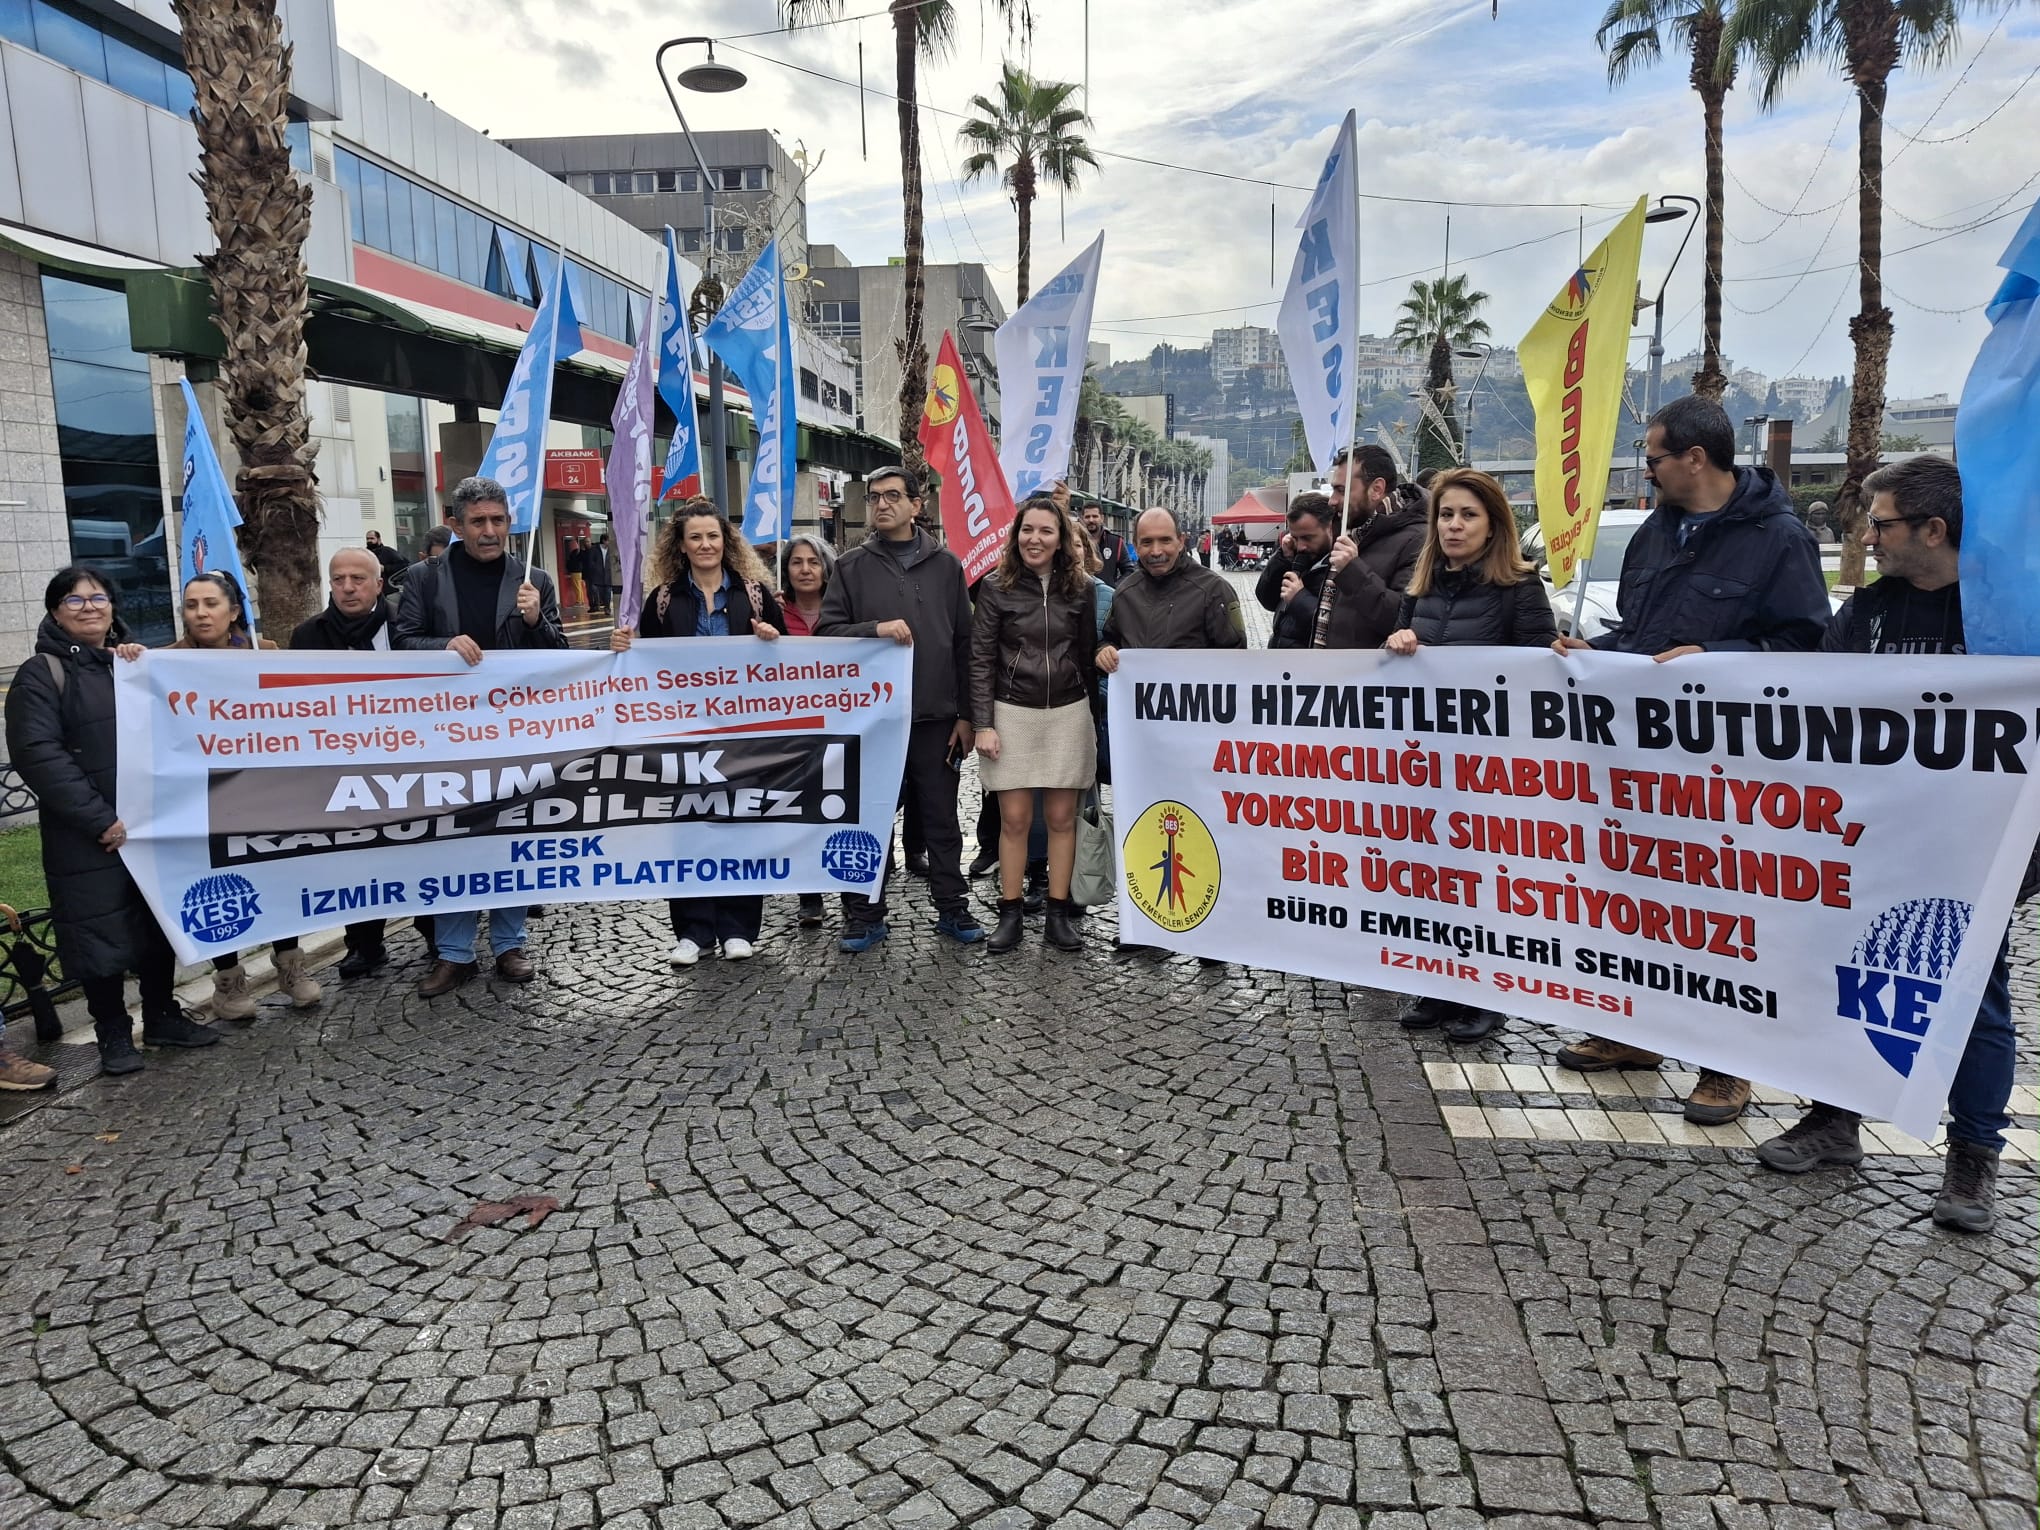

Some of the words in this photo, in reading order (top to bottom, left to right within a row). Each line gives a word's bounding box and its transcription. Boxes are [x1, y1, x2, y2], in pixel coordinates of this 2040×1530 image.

[568, 475, 579, 484] 24
[209, 695, 336, 721] Kamusal
[347, 691, 479, 716] Hizmetler
[488, 675, 648, 713] Çökertilirken
[656, 665, 738, 691] Sessiz
[746, 660, 861, 684] Kalanlara
[197, 730, 300, 756] Verilen
[309, 723, 425, 755] Teşviğe,
[615, 699, 698, 725] SESsiz
[1135, 682, 1236, 724] KAMU
[1251, 671, 1510, 737] HİZMETLERİ
[1531, 677, 1617, 747] BİR
[1635, 682, 2040, 775] BÜTÜNDÜR
[325, 750, 728, 813] AYRIMCILIK
[495, 787, 803, 829] EDİLEMEZ
[1212, 739, 1441, 789] AYRIMCILIĞI
[1454, 752, 1598, 805] KABUL
[1608, 764, 1865, 847] ETMİYOR,
[511, 835, 605, 862] KESK
[1164, 819, 1178, 831] BES
[1222, 791, 1437, 845] YOKSULLUK
[1448, 811, 1586, 866] SINIRI
[1599, 817, 1852, 910] ÜZERİNDE
[300, 878, 405, 917] İZMİR
[418, 863, 580, 906] ŞUBELER
[593, 857, 791, 887] PLATFORMU
[821, 850, 882, 870] KESK
[841, 870, 866, 883] 1995
[1126, 871, 1143, 901] BÜRO
[180, 893, 263, 934] KESK
[1282, 840, 1348, 888] BİR
[1360, 847, 1482, 908] ÜCRET
[1496, 864, 1758, 962] İSTİYORUZ!
[209, 922, 240, 942] 1995
[1267, 896, 1348, 929] BÜRO
[1360, 912, 1562, 967] EMEKÇİLERİ
[1575, 947, 1778, 1019] SENDİKASI
[1380, 947, 1481, 983] İZMİR
[1492, 971, 1634, 1017] ŞUBESİ
[1835, 964, 1943, 1037] KE
